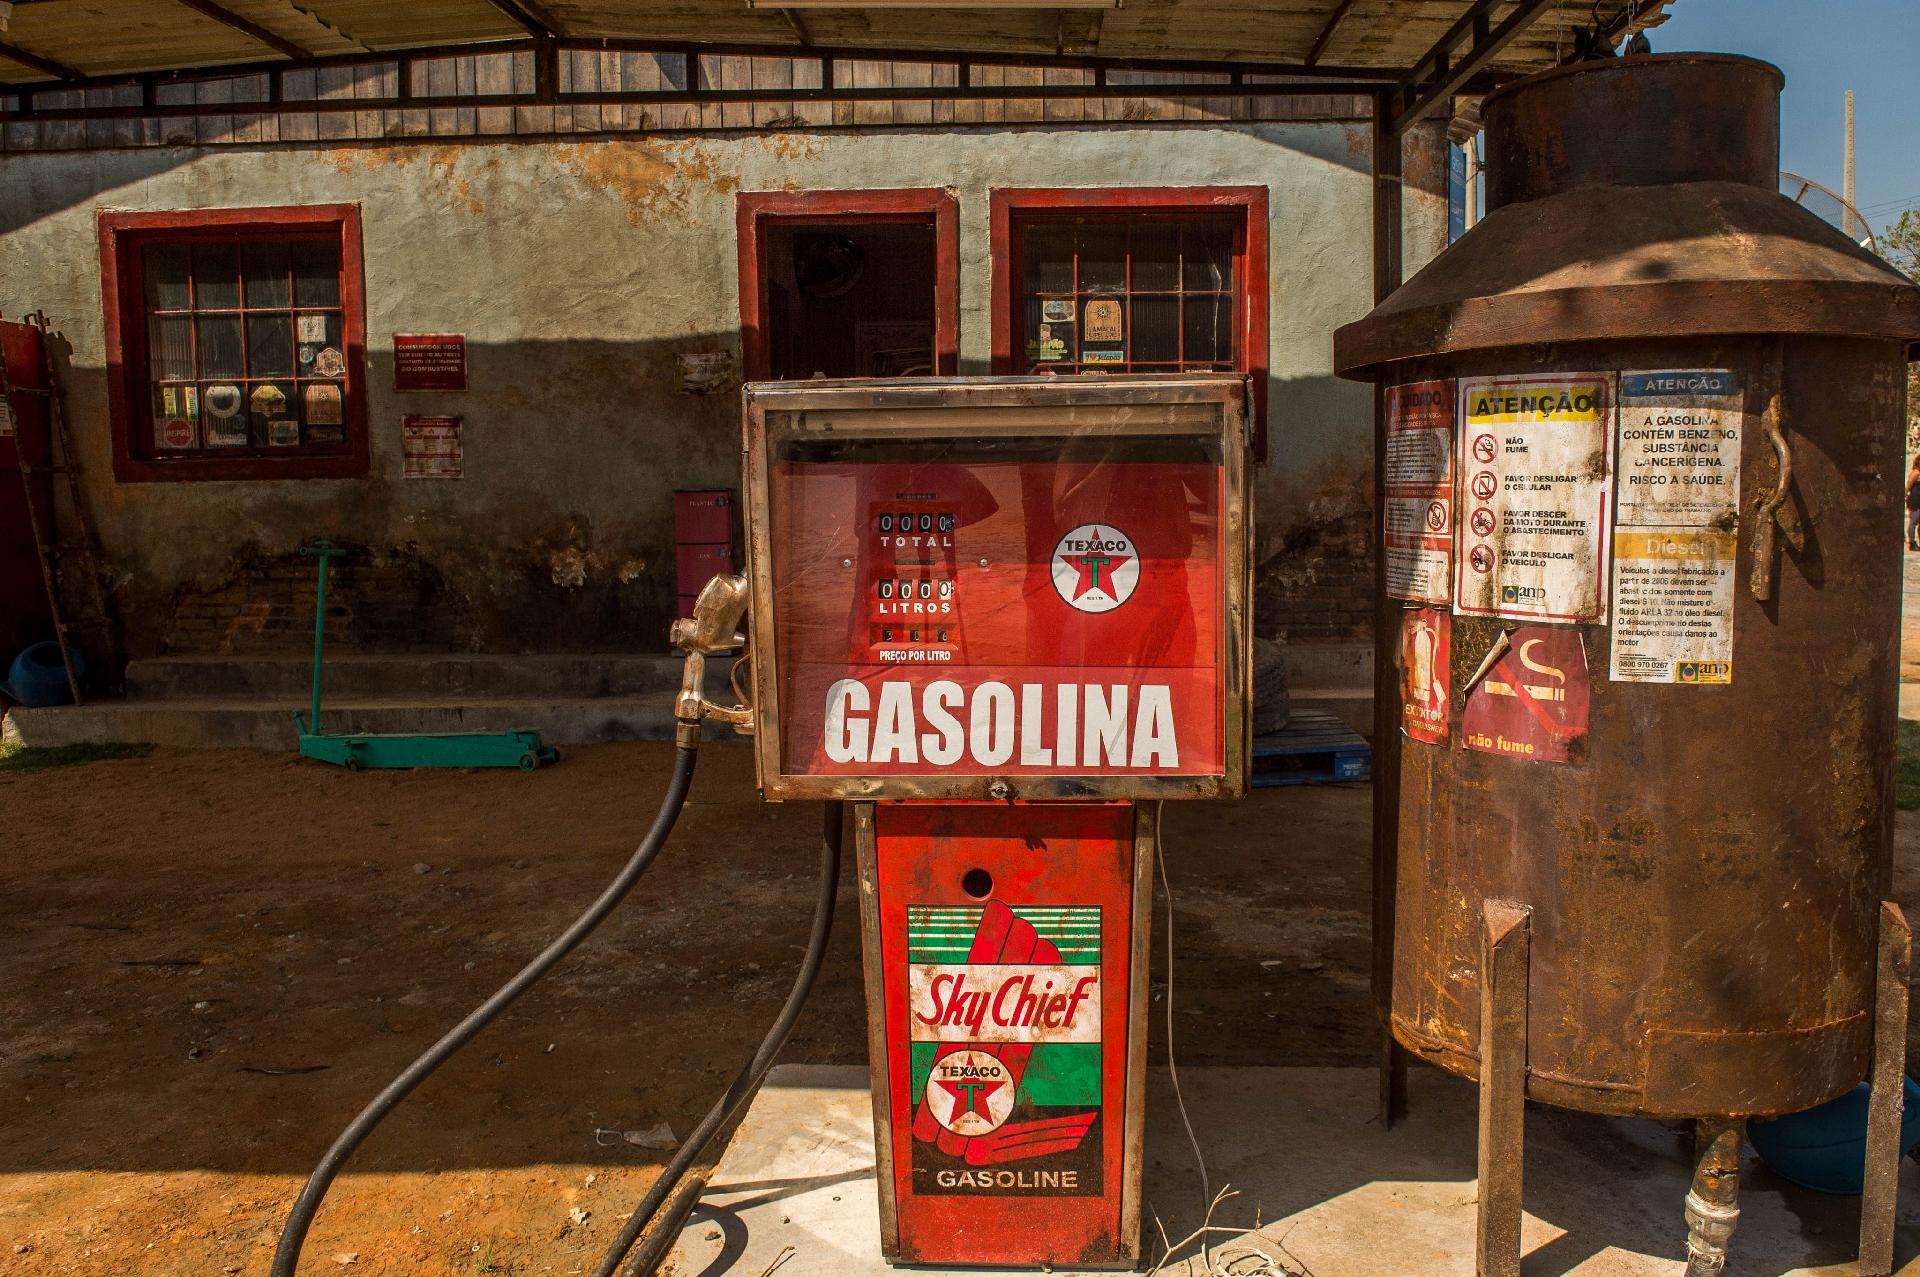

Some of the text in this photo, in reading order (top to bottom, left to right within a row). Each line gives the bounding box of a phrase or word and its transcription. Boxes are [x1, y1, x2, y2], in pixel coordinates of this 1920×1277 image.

[1646, 377, 1721, 391] ATENÇÃO
[1476, 392, 1593, 418] ATENÇÃO
[1644, 415, 1718, 427] A GASOLINA
[1623, 428, 1738, 441] CONTÉM BENZNO,
[1505, 437, 1524, 445] NÃO
[1643, 441, 1718, 453] SUBSTÂNCIA
[1533, 475, 1577, 483] DESLIGAR
[1629, 475, 1666, 485] RISCO
[1683, 474, 1726, 485] SAÚDE.
[1503, 518, 1514, 526] DA
[1543, 519, 1586, 527] DURANTE
[1510, 527, 1585, 536] ABASTECIMENTO
[880, 536, 952, 547] TOTAL
[1065, 539, 1127, 552] TEXACO
[1647, 538, 1704, 555] Diesel
[1531, 551, 1575, 560] DESLIGAR
[1081, 556, 1110, 588] T
[1681, 568, 1719, 576] fabricados
[1670, 577, 1694, 585] devem
[1519, 586, 1546, 600] anp
[1664, 588, 1695, 596] somente
[879, 602, 951, 614] LITROS
[1677, 598, 1704, 606] misture
[1684, 608, 1700, 617] óleo
[1702, 609, 1724, 617] diesel.
[1618, 617, 1625, 625] O
[1684, 629, 1707, 637] danos
[879, 650, 951, 664] PREÇO POR LITRO
[1651, 661, 1668, 669] 0267
[824, 678, 1179, 768] GASOLINA
[1468, 734, 1534, 755] não fume
[915, 973, 1098, 1037] Sky Chief
[940, 1066, 1001, 1078] TEXACO
[956, 1082, 985, 1112] T
[936, 1170, 1078, 1188] GASOLINE
